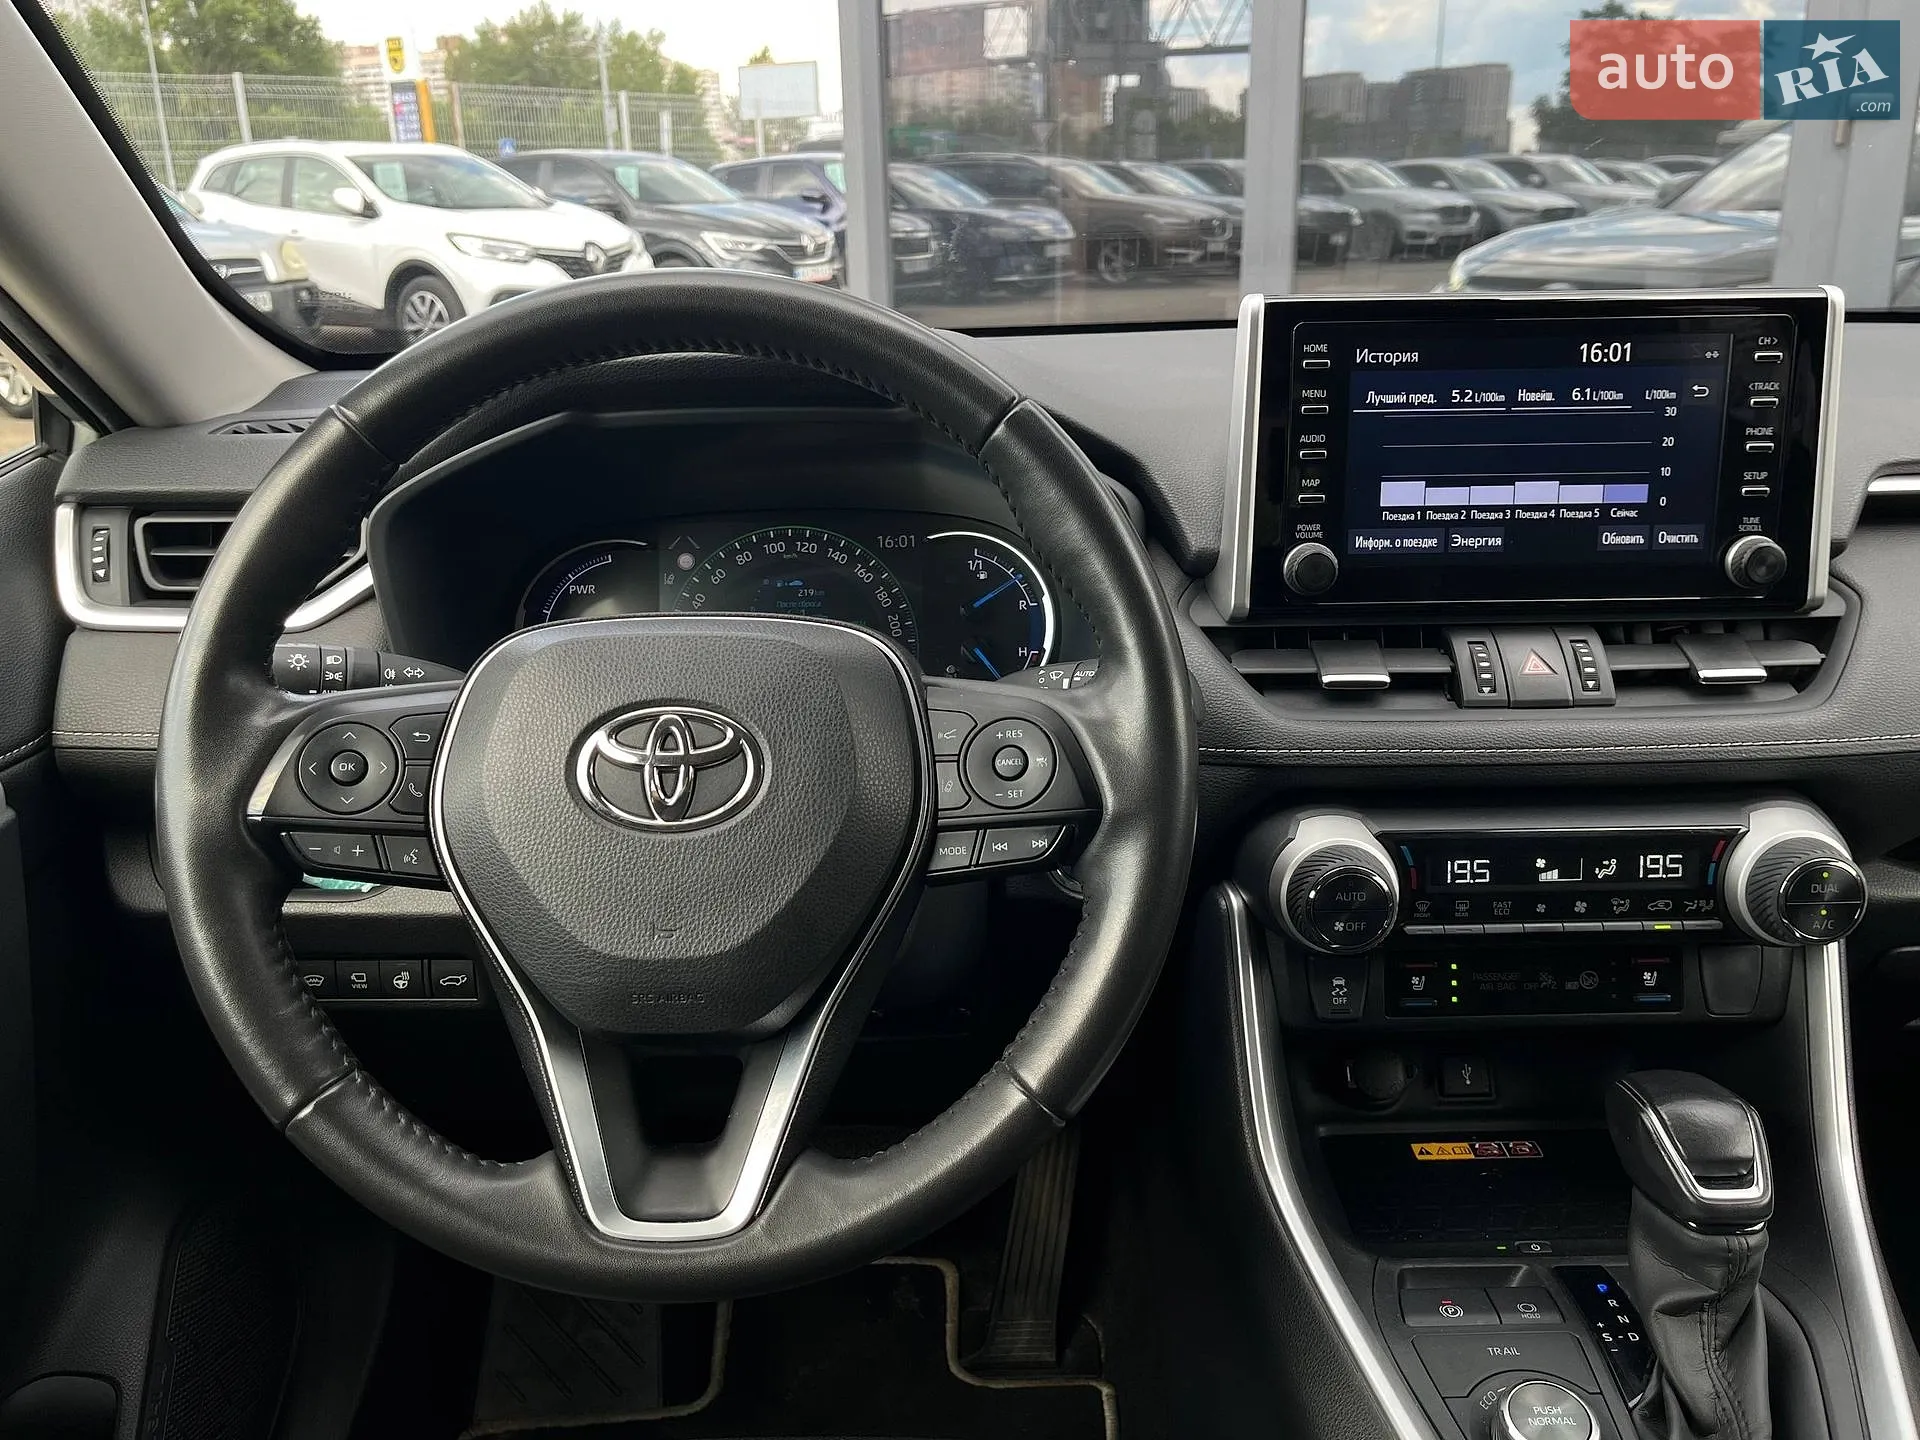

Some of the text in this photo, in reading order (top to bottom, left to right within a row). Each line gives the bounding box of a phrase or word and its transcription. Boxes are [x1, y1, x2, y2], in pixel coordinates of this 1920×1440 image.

[1303, 344, 1328, 353] HOME
[1580, 342, 1632, 363] 16:01
[1356, 349, 1419, 366] История
[1302, 389, 1327, 398] MENU
[1366, 391, 1407, 405] Лучший
[1409, 392, 1437, 405] пред.
[1451, 389, 1473, 402] 5.2
[1518, 389, 1555, 402] Новейш.
[1572, 388, 1591, 401] 6.1
[1664, 406, 1677, 417] 30
[1745, 427, 1774, 435] PHONE
[1300, 434, 1325, 443] AUDIO
[1662, 437, 1674, 447] 20
[1660, 467, 1671, 476] 10
[1743, 472, 1768, 480] SETUP
[1301, 478, 1321, 487] MAP
[1659, 497, 1667, 506] 0
[1382, 511, 1421, 521] Поездка 1
[1426, 511, 1466, 520] Поездка 2
[1471, 510, 1511, 519] Поездка 3
[1515, 509, 1555, 519] Поездка 4
[1559, 508, 1600, 519] Поездка 5
[1610, 508, 1638, 518] Сейчас
[877, 535, 915, 549] 16:01
[1451, 535, 1502, 549] Энергия
[1602, 532, 1645, 545] Обновить
[1658, 531, 1699, 544] Очистить
[763, 541, 786, 554] 100
[795, 541, 817, 554] 120
[1355, 536, 1438, 550] Информ. о поездке
[735, 551, 753, 566] 80
[827, 547, 848, 565] 140
[968, 560, 983, 571] 1/1
[710, 568, 727, 585] 60
[853, 563, 874, 584] 160
[569, 584, 596, 595] PWR
[798, 588, 814, 597] 219
[692, 593, 706, 609] 40
[874, 585, 892, 609] 180
[1019, 600, 1028, 610] R
[887, 614, 901, 637] 200
[1018, 646, 1028, 657] H
[1005, 730, 1023, 738] RES
[339, 763, 356, 771] OK
[997, 758, 1023, 766] CANCEL
[1007, 790, 1024, 798] SET
[939, 846, 967, 855] MODE
[1447, 859, 1490, 884] 19.5
[1639, 854, 1683, 879] 19.5
[1811, 883, 1839, 893] DUAL
[1335, 891, 1366, 902] AUTO
[1494, 908, 1510, 916] ECO
[1346, 921, 1367, 932] OFF
[1813, 919, 1835, 930] A/C
[1332, 997, 1347, 1005] OFF
[1607, 1299, 1620, 1307] R
[1616, 1314, 1630, 1324] N
[1602, 1332, 1640, 1341] S D
[1487, 1347, 1520, 1356] TRAIL
[1479, 1390, 1497, 1410] ECO
[1533, 1406, 1562, 1415] PUSH
[1528, 1416, 1576, 1426] NORMAL
